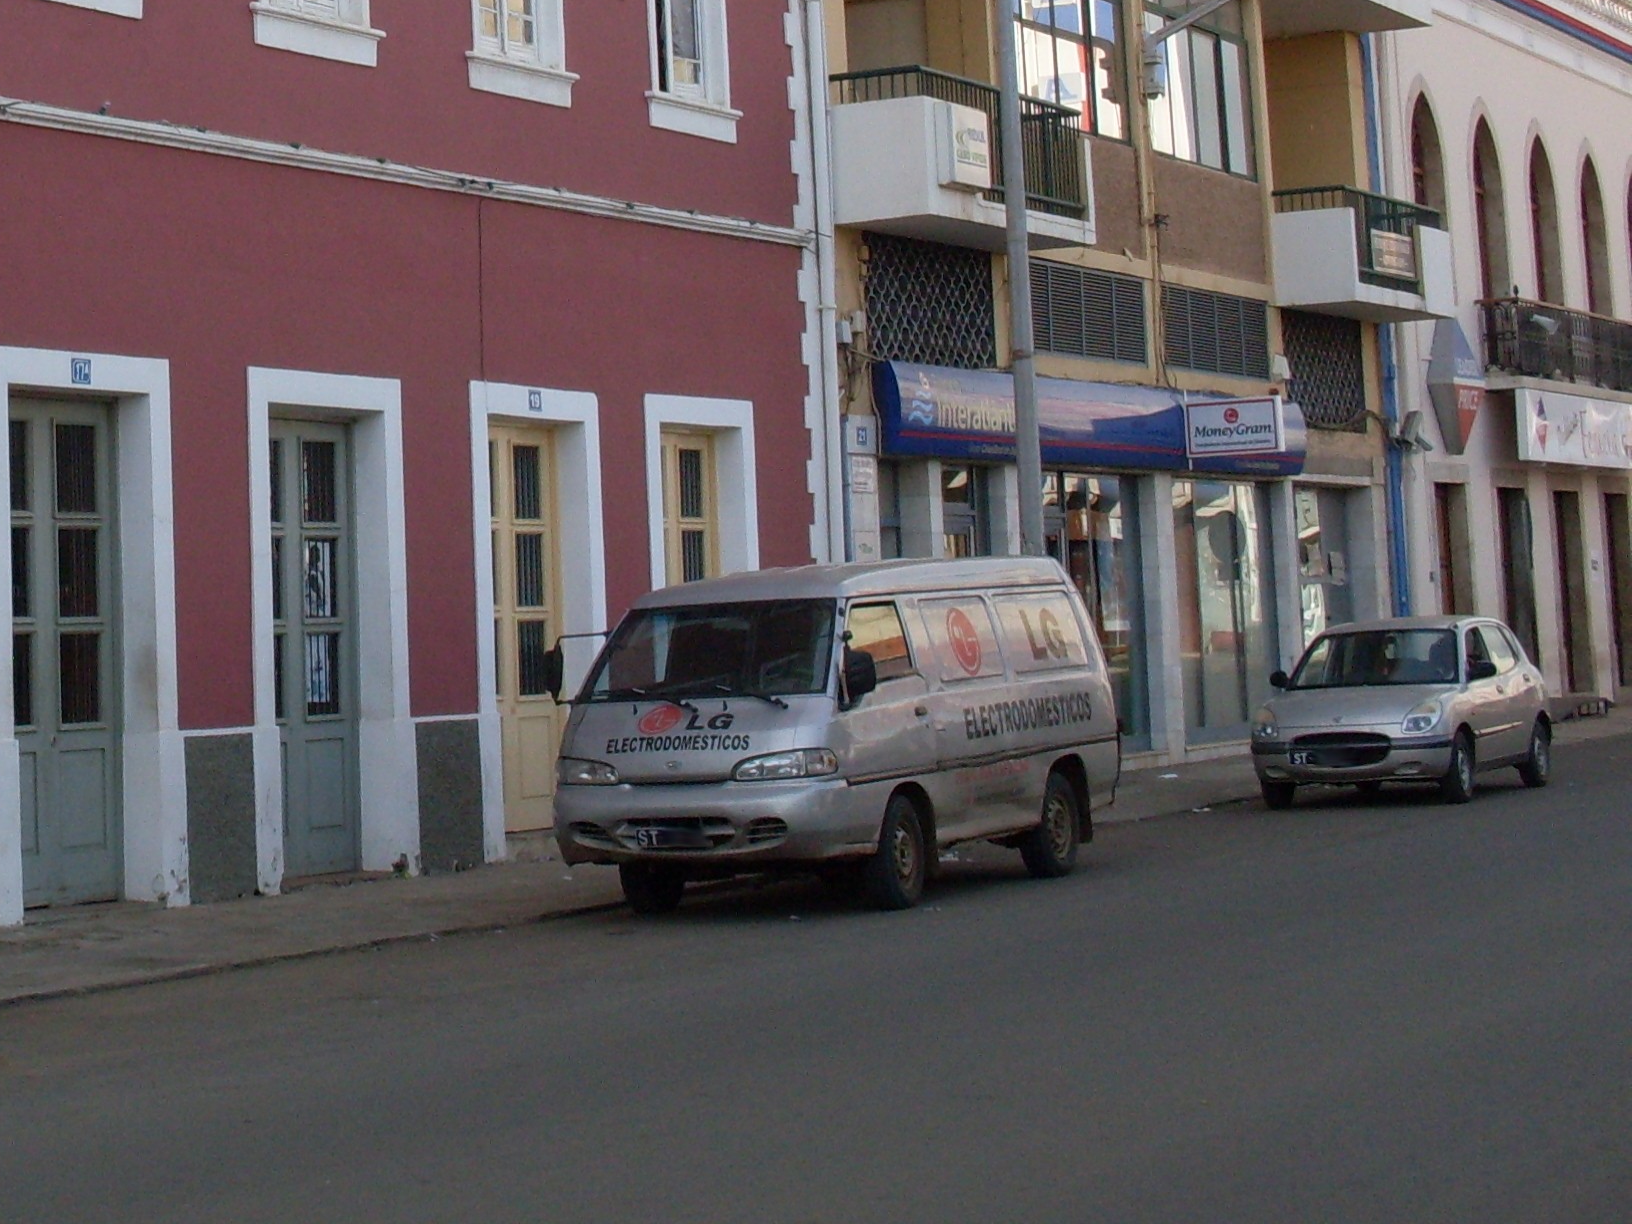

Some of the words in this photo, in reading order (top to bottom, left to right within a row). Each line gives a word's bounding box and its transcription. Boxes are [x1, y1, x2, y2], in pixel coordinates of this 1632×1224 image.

[530, 392, 540, 408] 19
[1194, 422, 1272, 439] MoneyGram
[1018, 607, 1068, 661] LG
[685, 712, 734, 730] LG
[962, 691, 1092, 740] ELECTRODOMESTICOS
[605, 734, 750, 754] ELECTRODOMESTICOS
